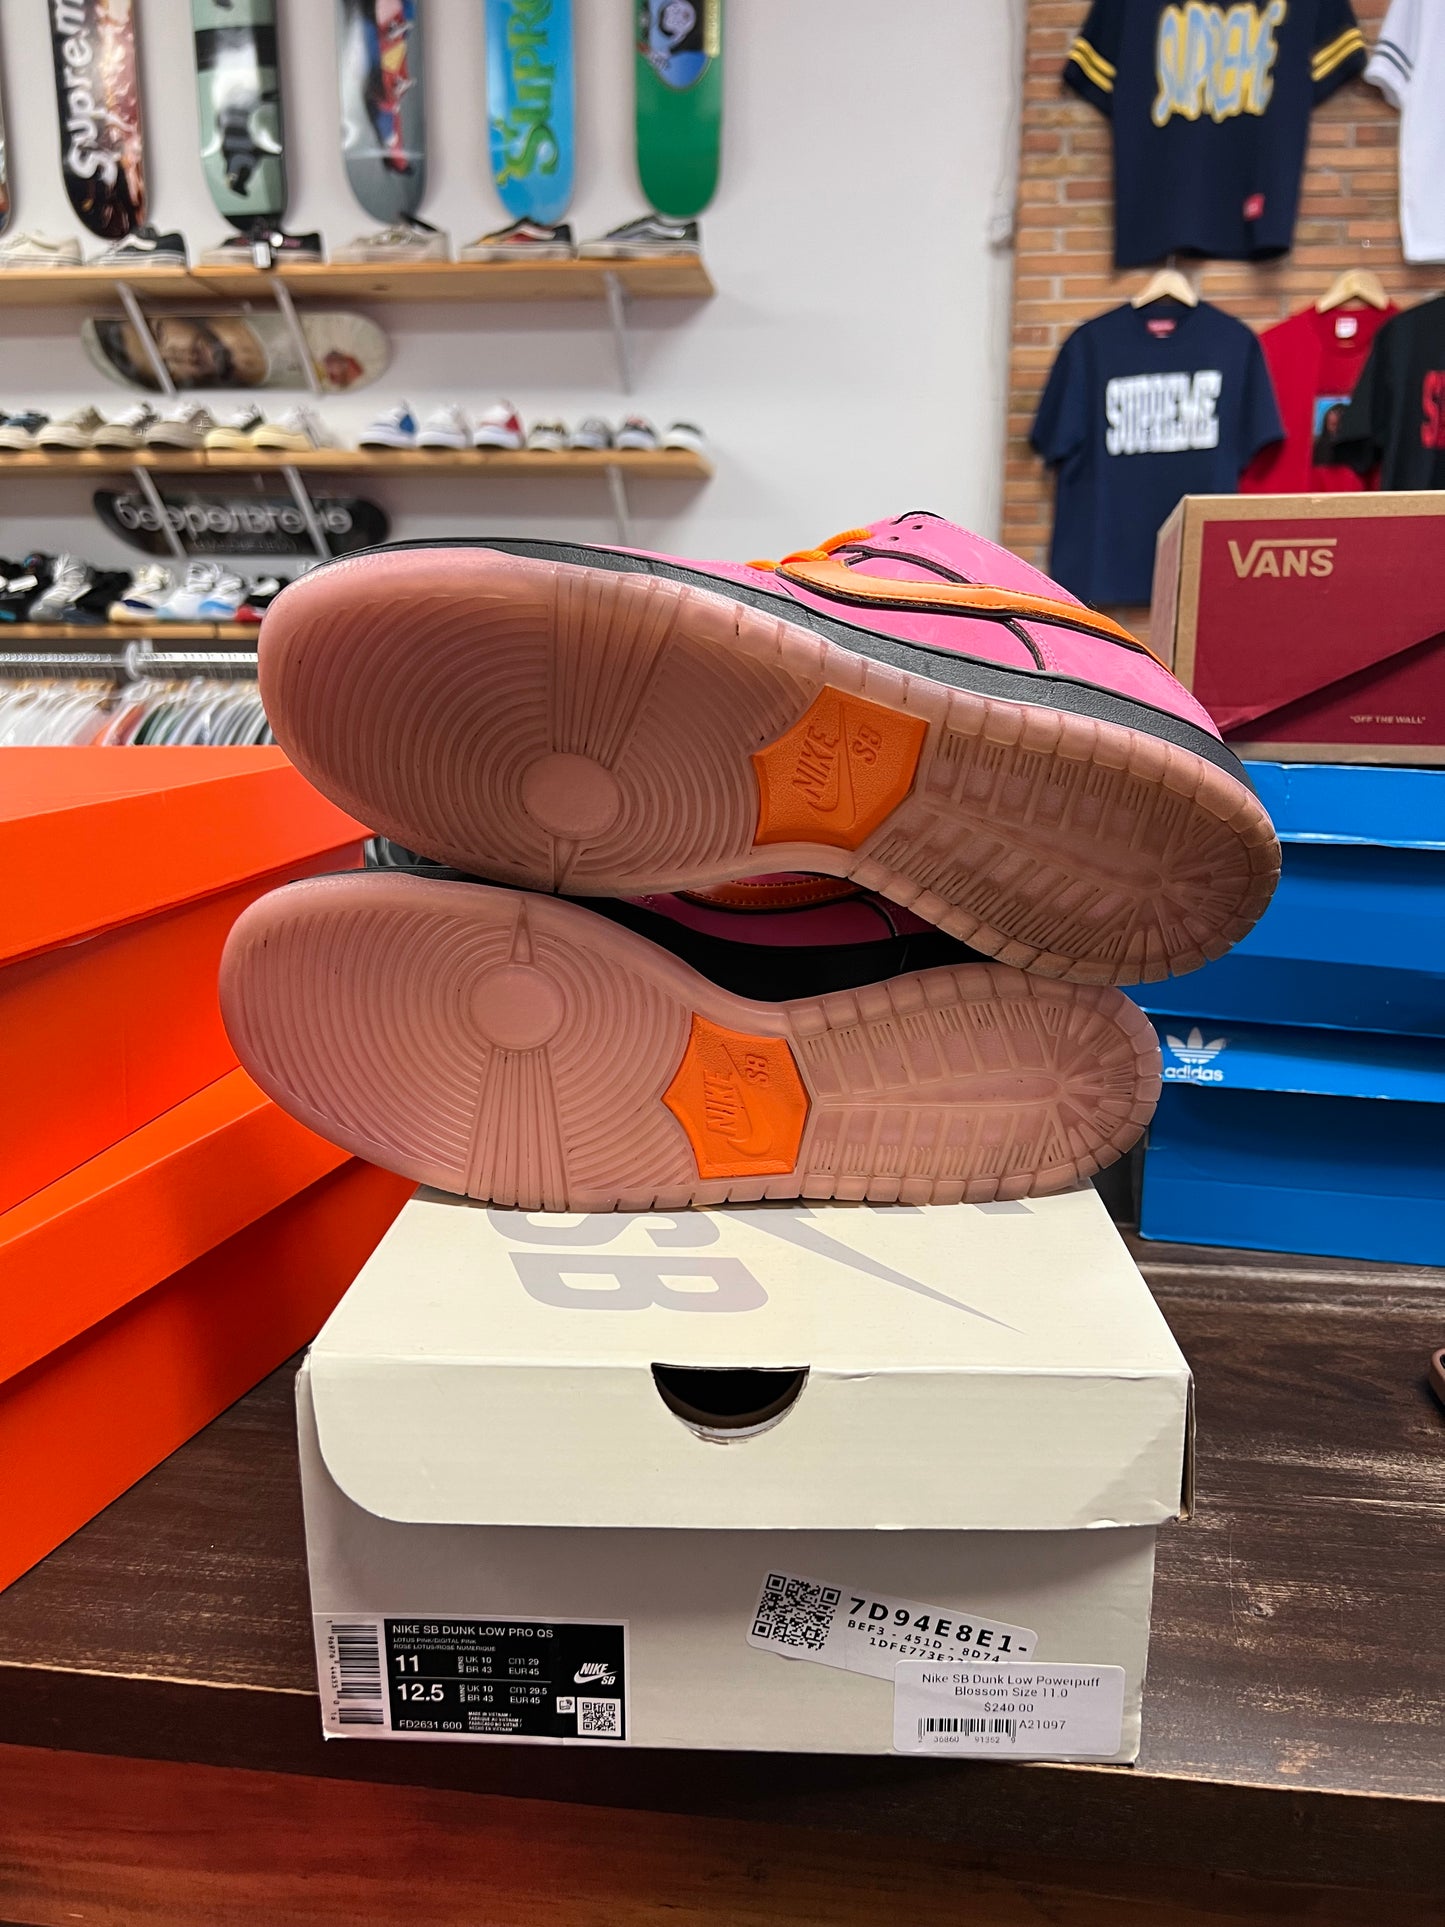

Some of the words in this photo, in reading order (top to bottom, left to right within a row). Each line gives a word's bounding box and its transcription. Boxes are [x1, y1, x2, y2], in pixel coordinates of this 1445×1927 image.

[1228, 538, 1337, 578] VANS
[1375, 715, 1394, 724] THE
[852, 724, 882, 767] SB
[791, 725, 839, 801] NIKE
[745, 1053, 770, 1087] SB
[1164, 1064, 1224, 1082] adidas
[703, 1069, 738, 1137] NIKE
[849, 1597, 1028, 1653] 7D94E8E1-
[392, 1625, 420, 1634] NIKE
[423, 1625, 439, 1634] SB
[442, 1626, 476, 1635] DUNK
[478, 1627, 506, 1637] LOW
[508, 1628, 533, 1637] PRO
[537, 1629, 554, 1638] QS
[847, 1619, 885, 1636] BEF3
[904, 1633, 943, 1649] 451D
[962, 1647, 1000, 1662] 8D74
[395, 1654, 419, 1672] 11
[465, 1656, 478, 1664] UK
[481, 1656, 492, 1664] 10
[528, 1658, 539, 1666] 29
[466, 1665, 479, 1673] BR
[481, 1666, 492, 1674] 43
[508, 1667, 528, 1675] EUR
[528, 1668, 540, 1676] 45
[580, 1663, 609, 1675] NIKE
[601, 1676, 616, 1685] SB
[922, 1673, 949, 1683] Nike
[952, 1674, 969, 1683] SB
[972, 1674, 1004, 1685] Dunk
[1007, 1675, 1034, 1685] Low
[1036, 1676, 1101, 1688] Powerpuff
[397, 1683, 445, 1701] 12.5
[466, 1684, 480, 1692] UK
[482, 1685, 493, 1693] 10
[529, 1687, 548, 1695] 29.5
[954, 1686, 1008, 1696] Blossom
[1012, 1687, 1038, 1697] Size
[1042, 1687, 1068, 1698] 11.0
[510, 1695, 528, 1704] EUR
[529, 1696, 541, 1704] 45
[399, 1719, 439, 1729] FD2631
[442, 1721, 462, 1730] 600
[1018, 1719, 1067, 1730] A21097
